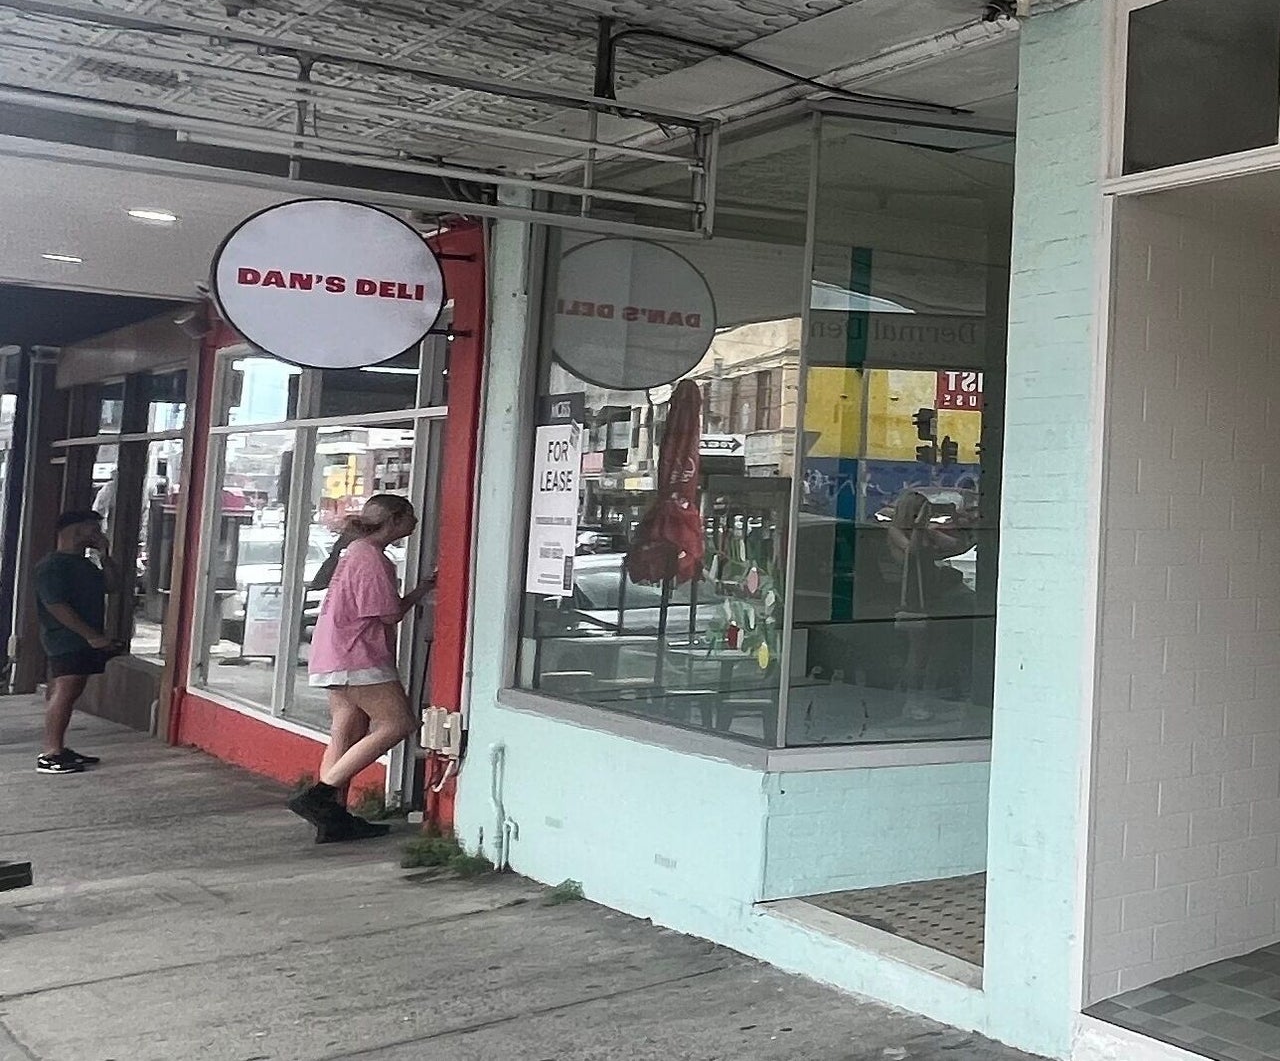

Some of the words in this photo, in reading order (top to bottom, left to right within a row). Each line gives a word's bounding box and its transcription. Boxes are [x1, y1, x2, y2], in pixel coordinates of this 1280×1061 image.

[355, 278, 425, 301] DELI
[547, 440, 570, 462] FOR
[539, 470, 574, 493] LEASE
